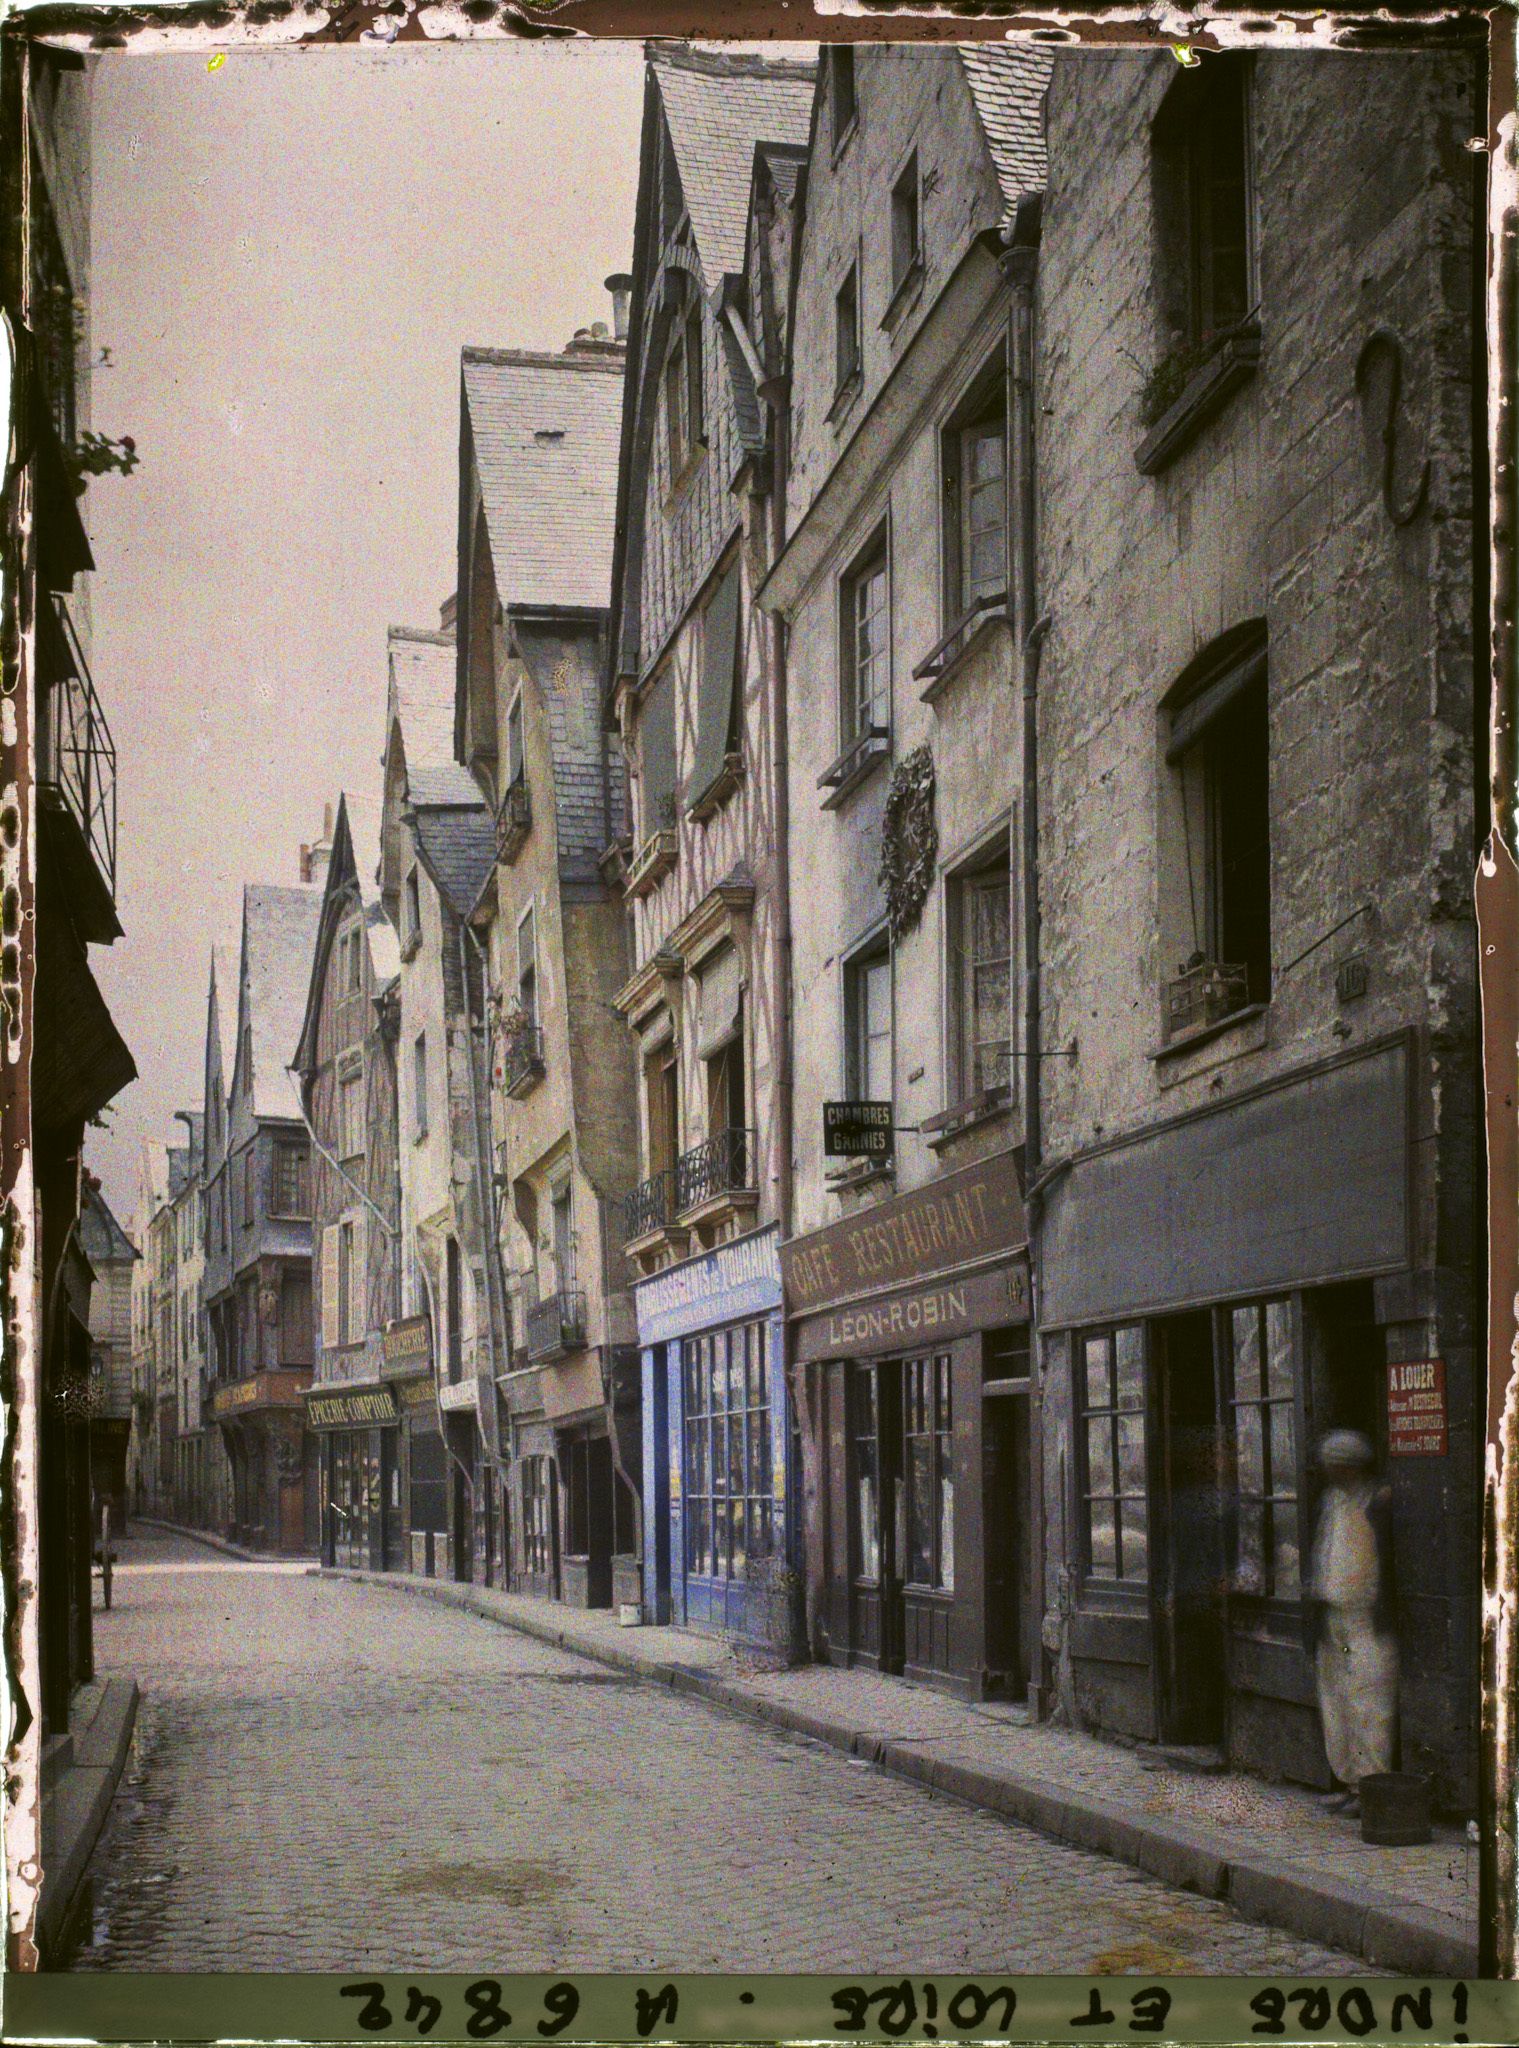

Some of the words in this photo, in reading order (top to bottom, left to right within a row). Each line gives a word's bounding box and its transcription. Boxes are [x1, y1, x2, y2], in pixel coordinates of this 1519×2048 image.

[827, 1106, 890, 1126] CHAMBRES
[833, 1131, 886, 1151] GARNIES
[848, 1184, 991, 1277] RESTAURANT
[1390, 1367, 1398, 1391] A
[1400, 1363, 1436, 1391] LOUER
[634, 1983, 679, 2037] A
[1069, 1986, 1172, 2033] ET
